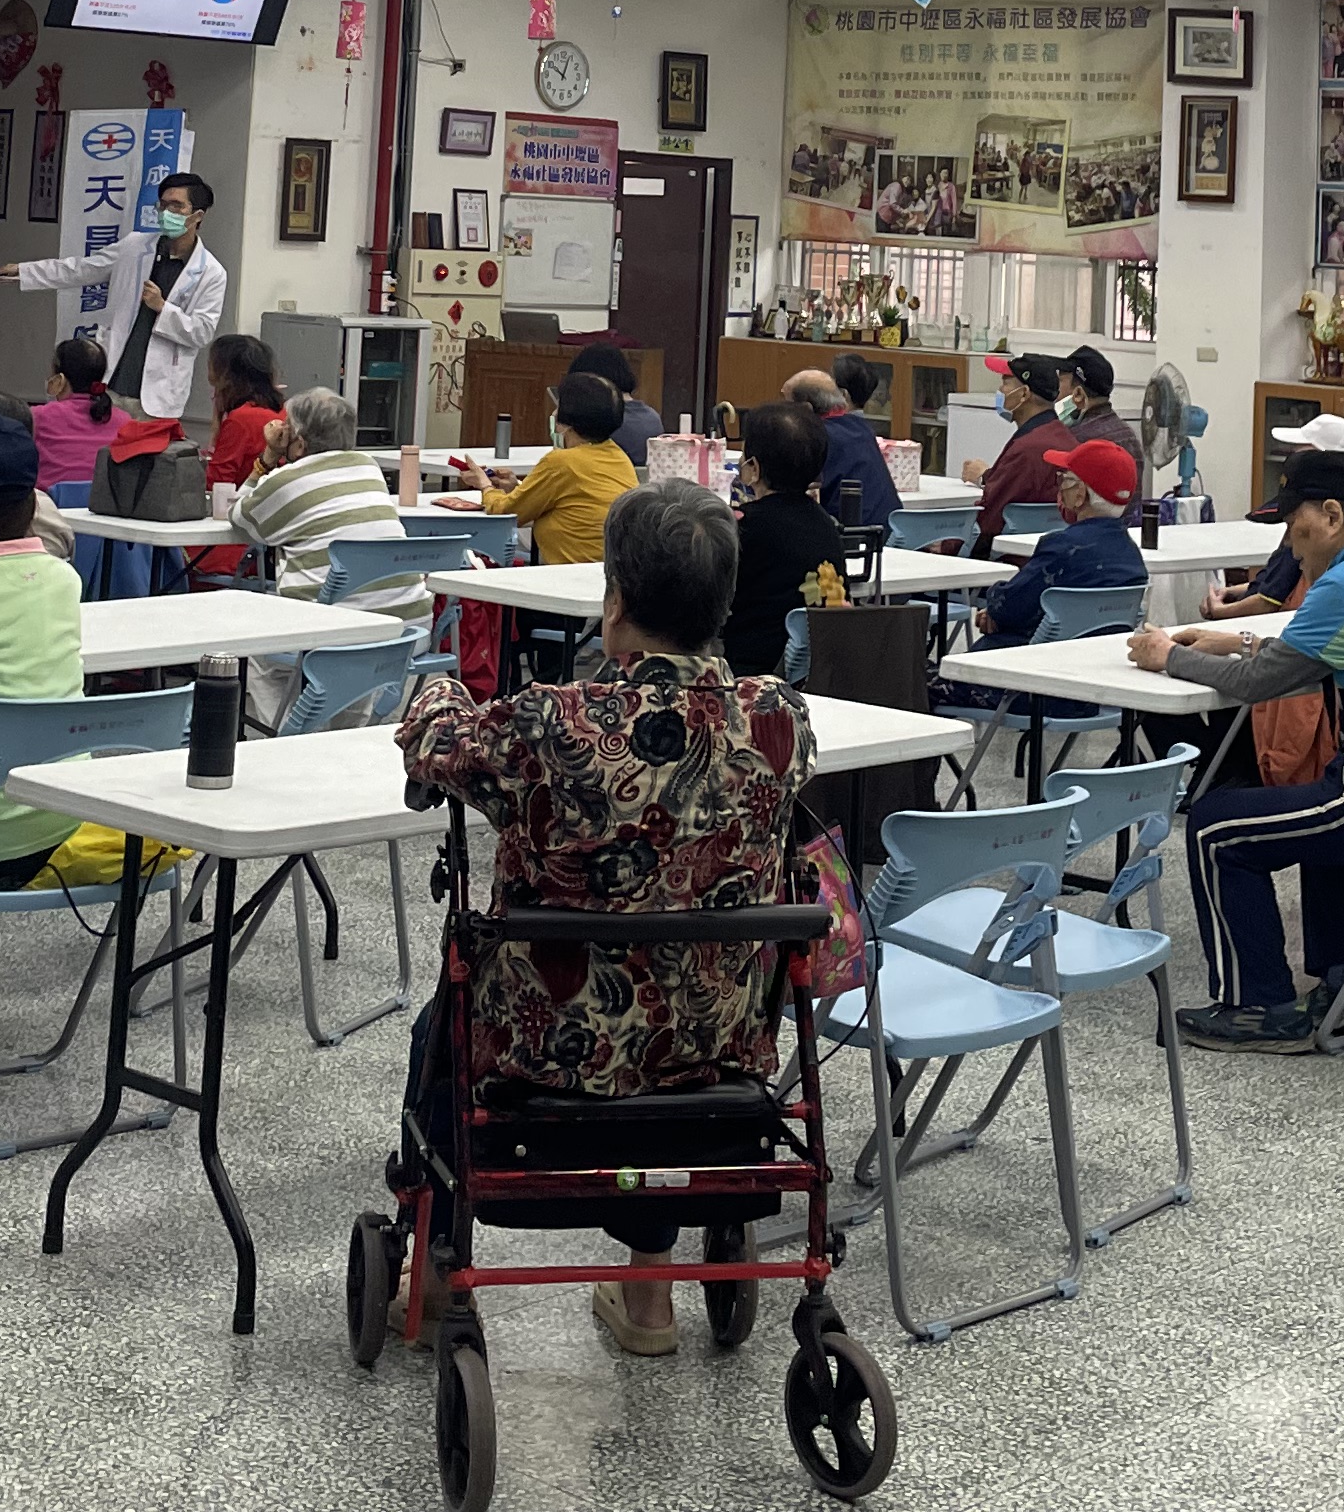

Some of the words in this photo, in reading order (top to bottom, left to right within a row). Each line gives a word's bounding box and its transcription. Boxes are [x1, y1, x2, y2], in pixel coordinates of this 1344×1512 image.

[834, 6, 1152, 32] 桃園市中壢區永福社區發展協會
